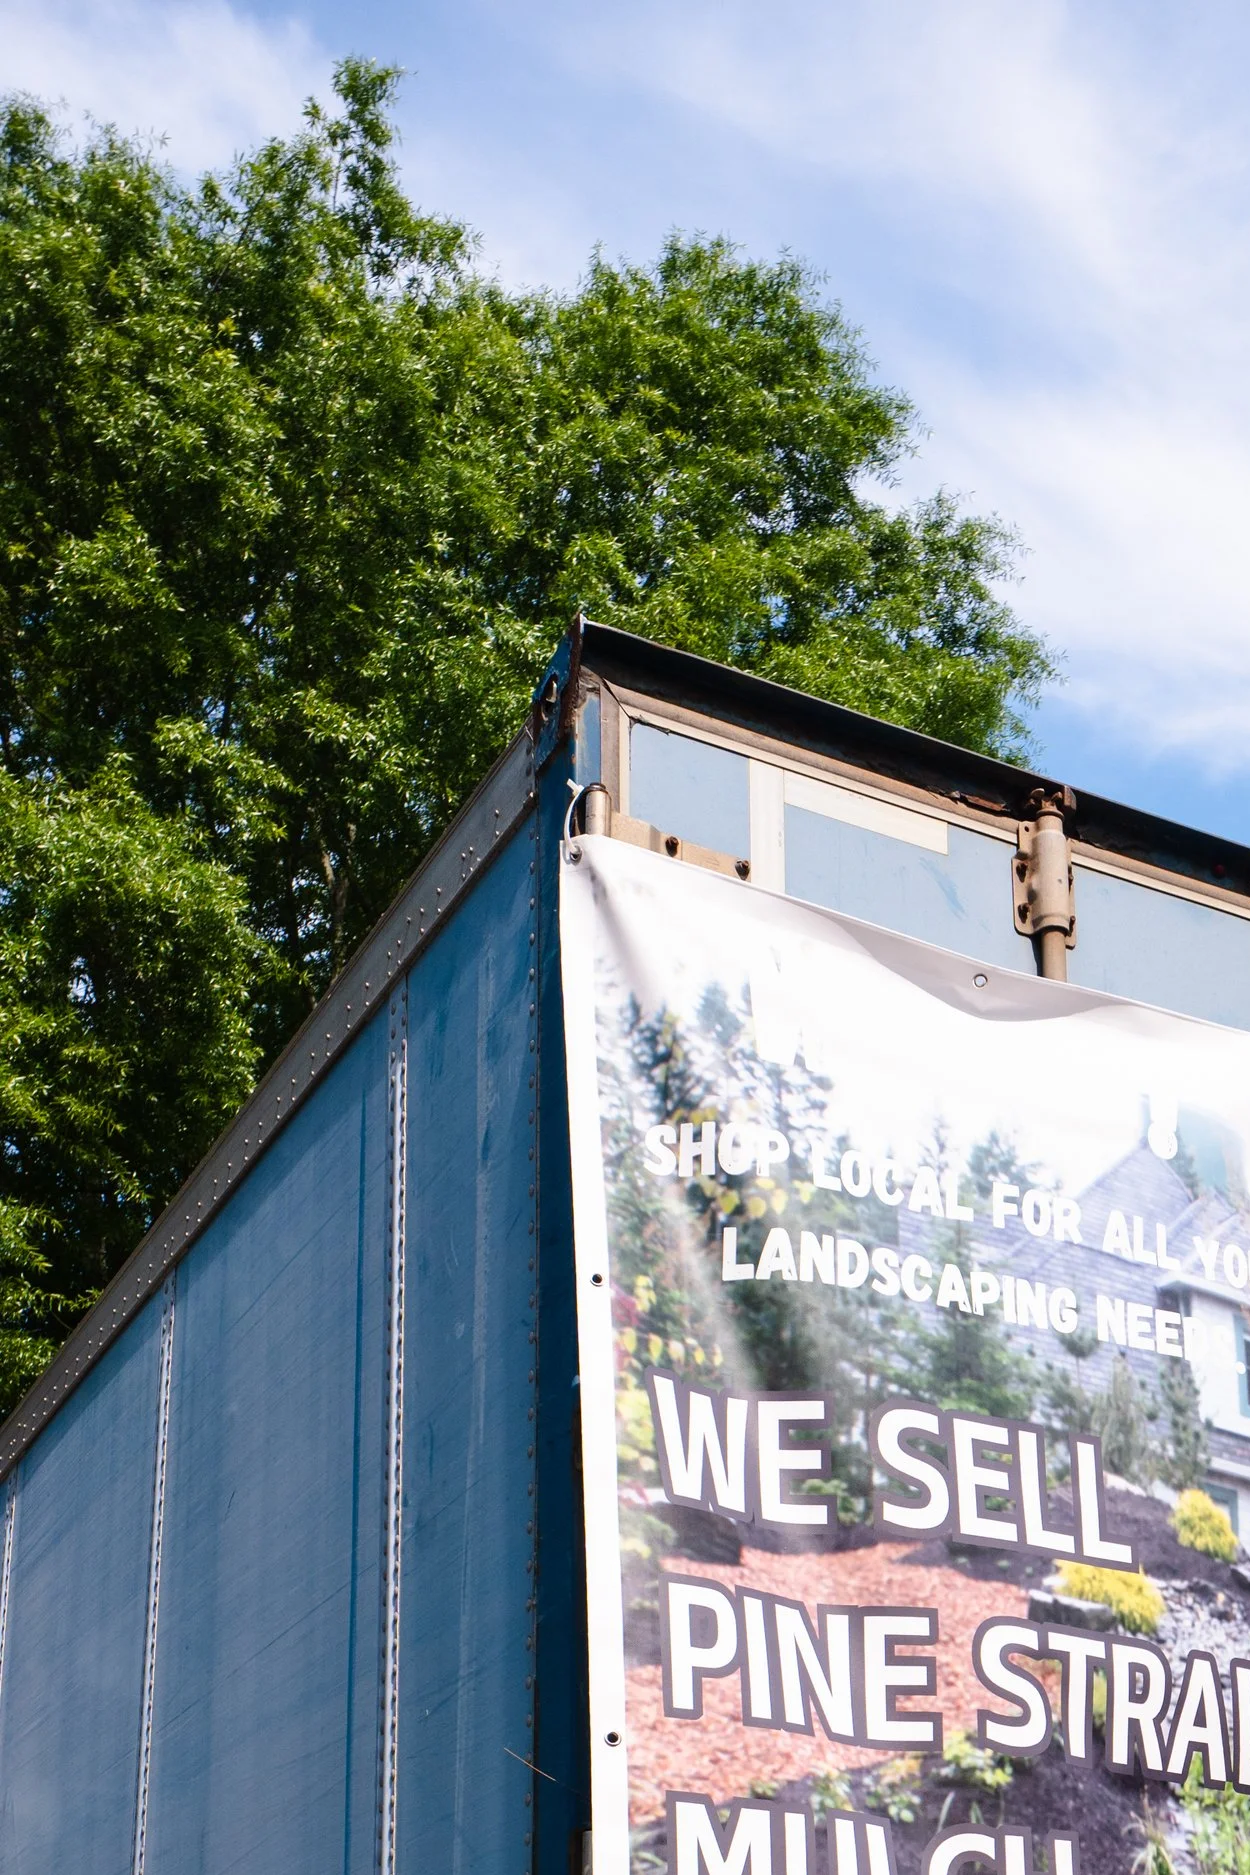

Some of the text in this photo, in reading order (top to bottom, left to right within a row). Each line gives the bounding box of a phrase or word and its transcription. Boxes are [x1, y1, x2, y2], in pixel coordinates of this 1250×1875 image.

[643, 1121, 791, 1178] SHOP
[810, 1143, 975, 1223] LOCAL
[992, 1181, 1083, 1245] FOR
[1102, 1210, 1181, 1270] ALL
[722, 1226, 1079, 1334] LANDSCAPING
[653, 1375, 1133, 1565] WE SELL
[667, 1581, 938, 1743] PINE
